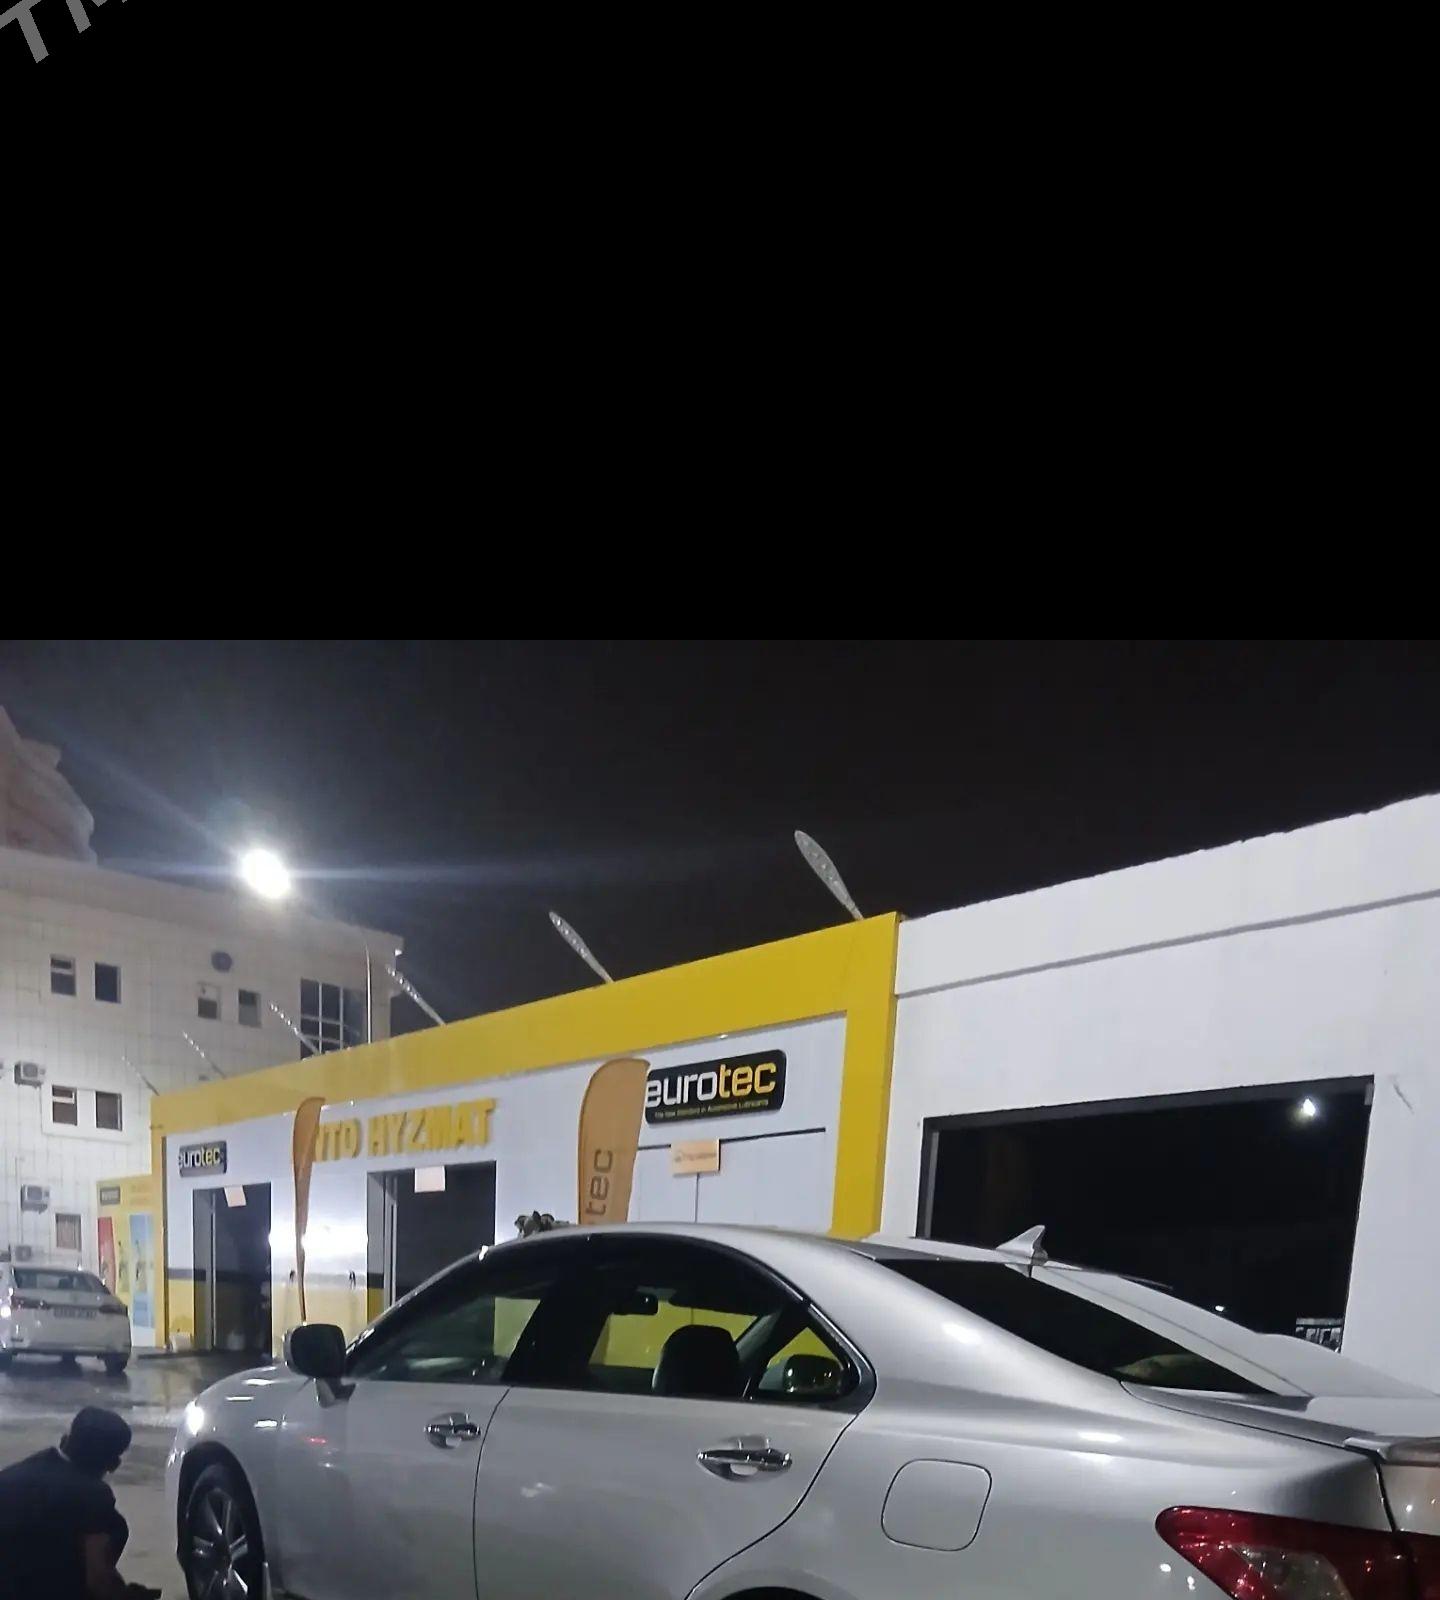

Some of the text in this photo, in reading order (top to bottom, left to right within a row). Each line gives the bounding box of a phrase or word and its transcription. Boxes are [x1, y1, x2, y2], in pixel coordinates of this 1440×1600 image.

[645, 1062, 777, 1108] eurotec
[367, 1098, 496, 1157] HYZMAT
[585, 1148, 614, 1223] tec
